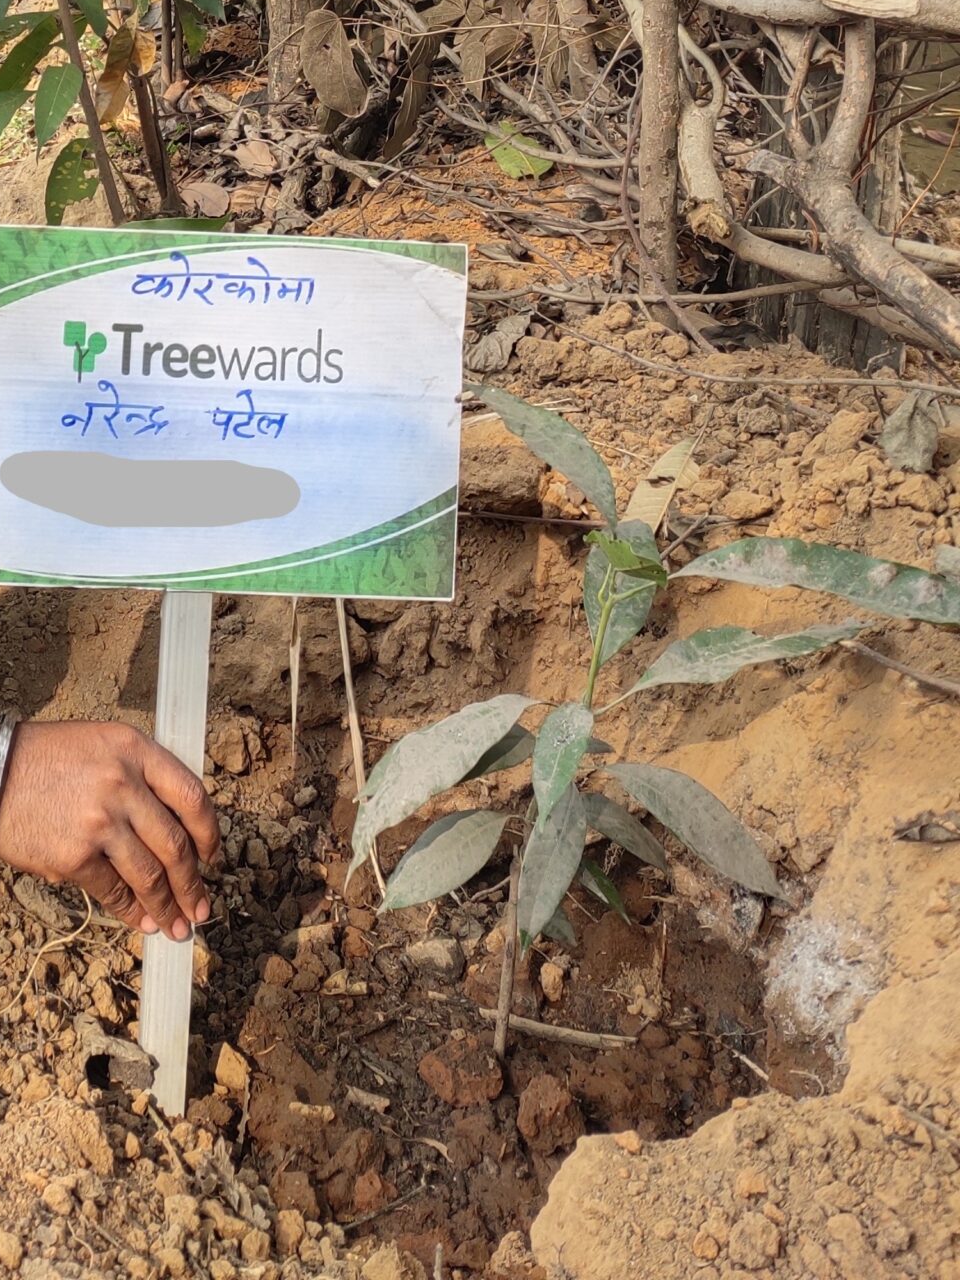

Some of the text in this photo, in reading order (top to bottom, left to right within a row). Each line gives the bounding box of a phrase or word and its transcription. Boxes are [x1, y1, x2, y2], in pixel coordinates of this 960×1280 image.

[131, 250, 315, 306] कोरकोमा
[111, 323, 345, 385] Treewards
[205, 388, 289, 441] पटेल
